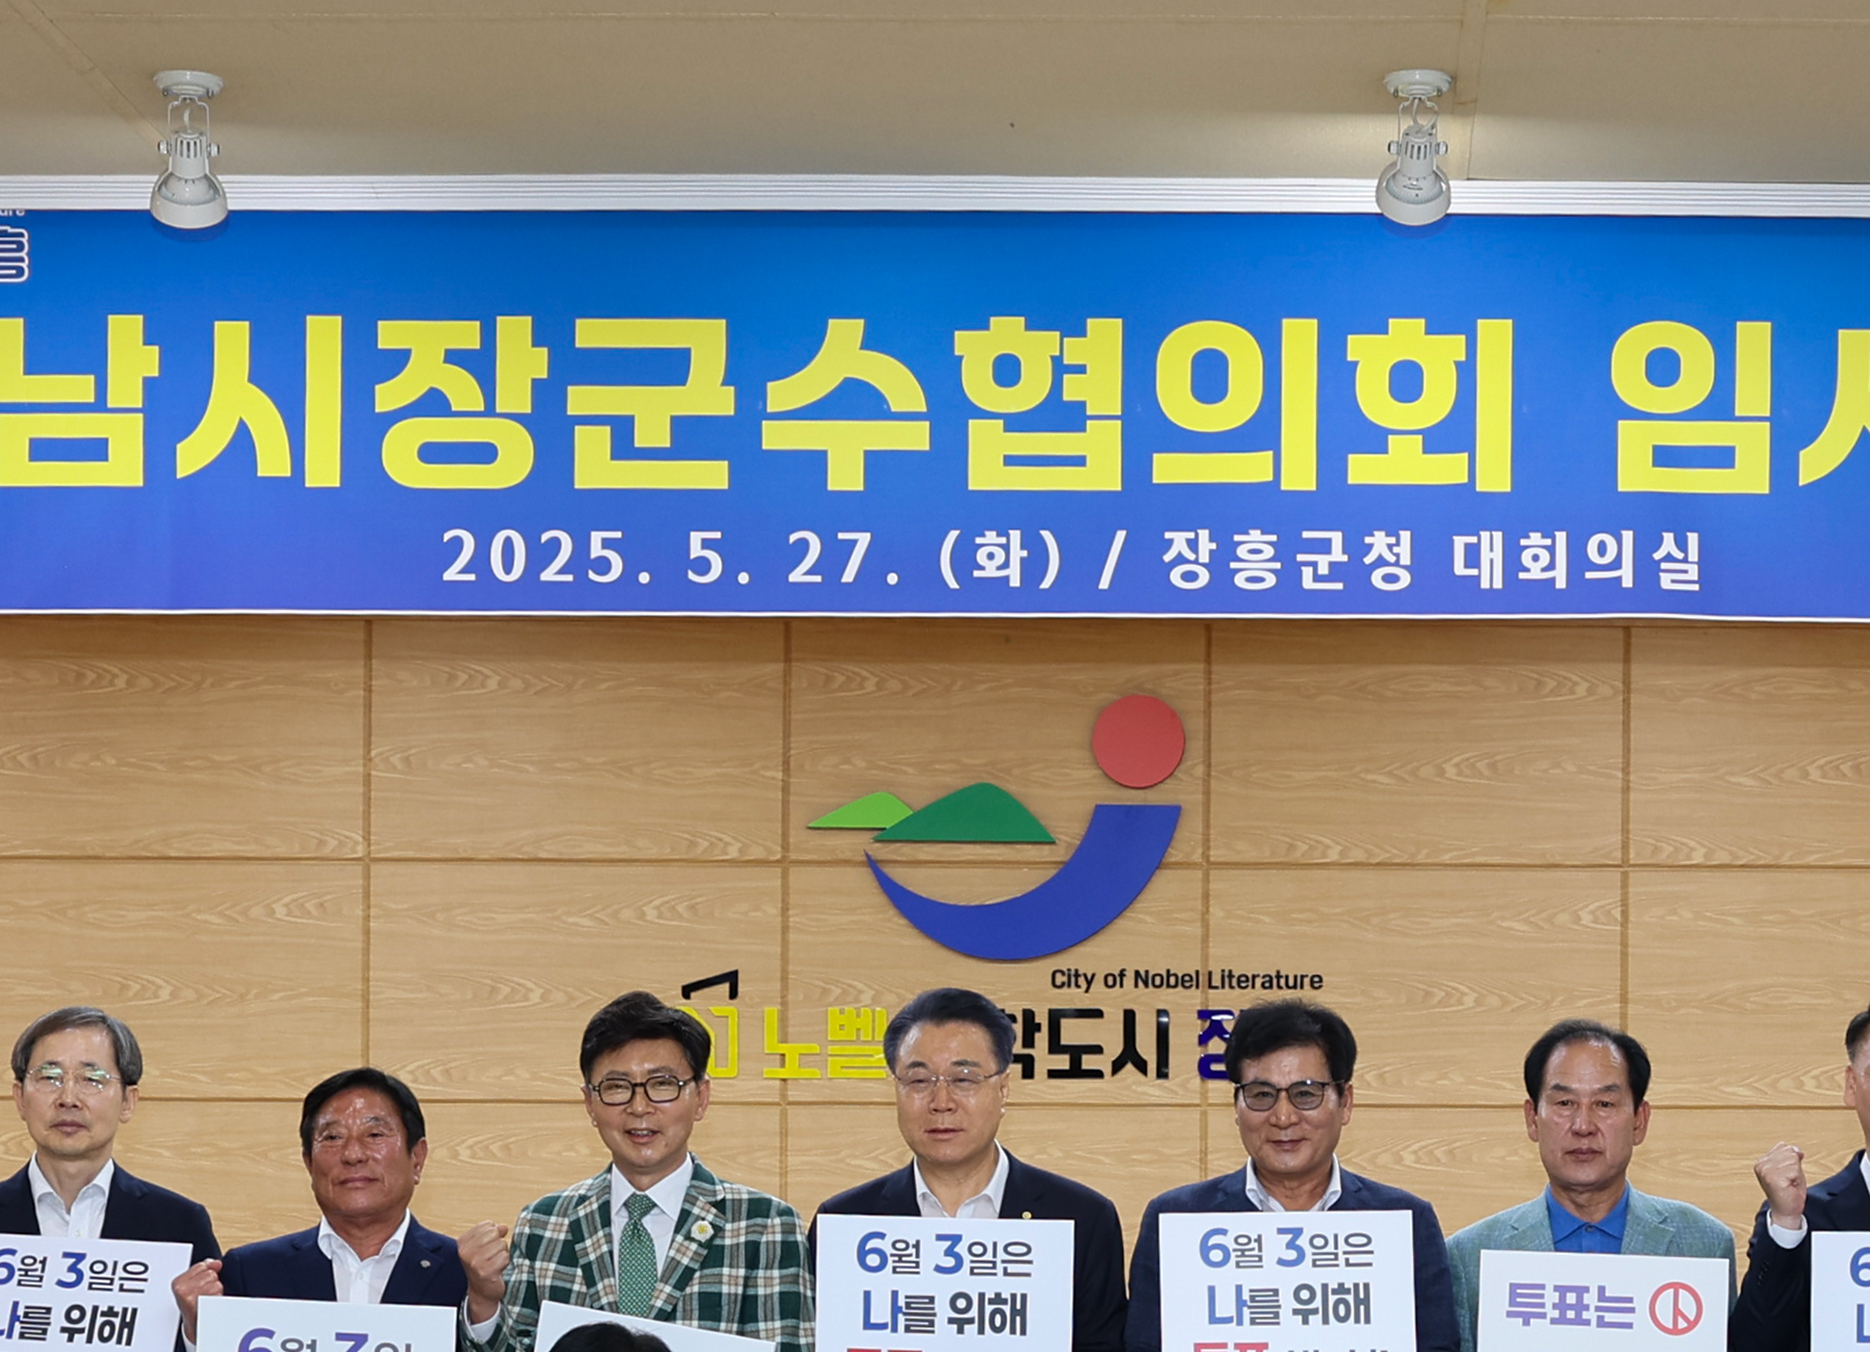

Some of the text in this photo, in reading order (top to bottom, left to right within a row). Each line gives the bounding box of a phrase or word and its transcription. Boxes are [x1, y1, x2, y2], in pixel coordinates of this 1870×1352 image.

[443, 529, 1701, 591] 2025. 5. 27. (화) 장흥군청 대회의실
[1051, 968, 1324, 993] City of Nobel Literature
[763, 1007, 888, 1079] 노벨
[857, 1231, 1033, 1277] 6월 3일은
[1200, 1227, 1374, 1269] 6월 3일은
[55, 1252, 149, 1293] 3일은
[59, 1304, 138, 1346] 위해
[863, 1290, 1027, 1336] 나를 위해
[1208, 1282, 1371, 1326] 나를 위해
[1506, 1283, 1635, 1329] 투표는
